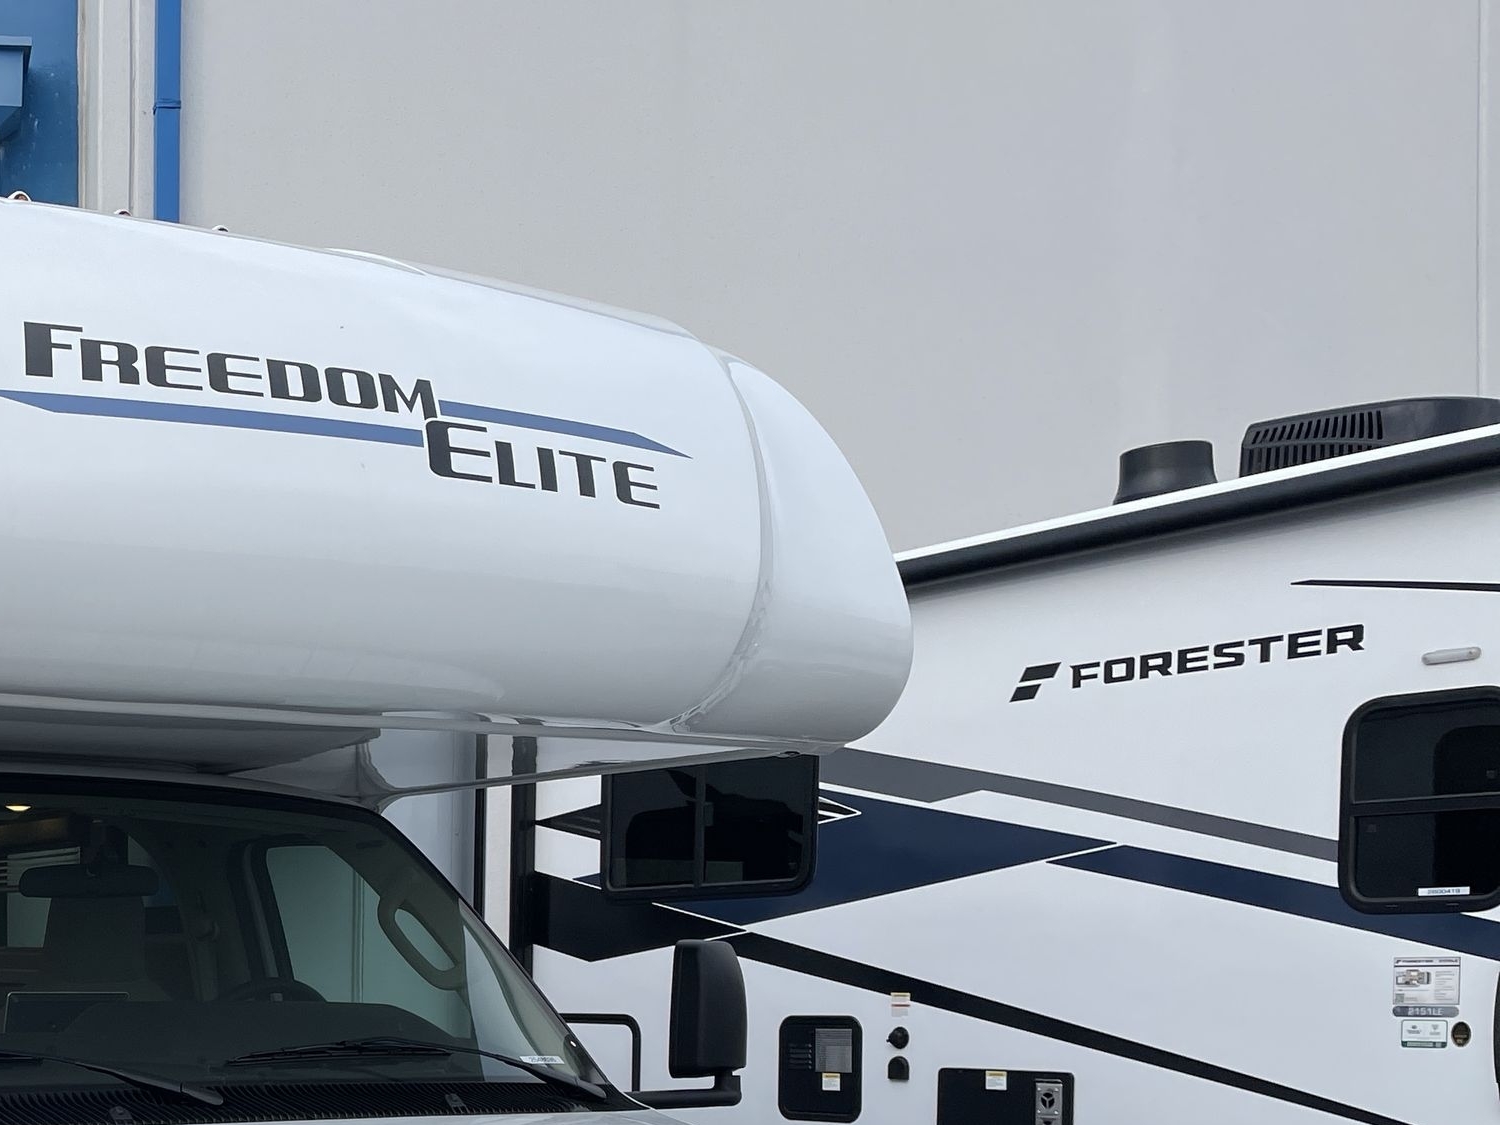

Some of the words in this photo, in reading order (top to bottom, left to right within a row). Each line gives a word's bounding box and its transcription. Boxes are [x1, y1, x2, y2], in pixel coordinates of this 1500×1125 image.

[23, 321, 437, 420] FREEDOM
[426, 419, 661, 510] ELITE
[1069, 623, 1366, 690] FORESTER
